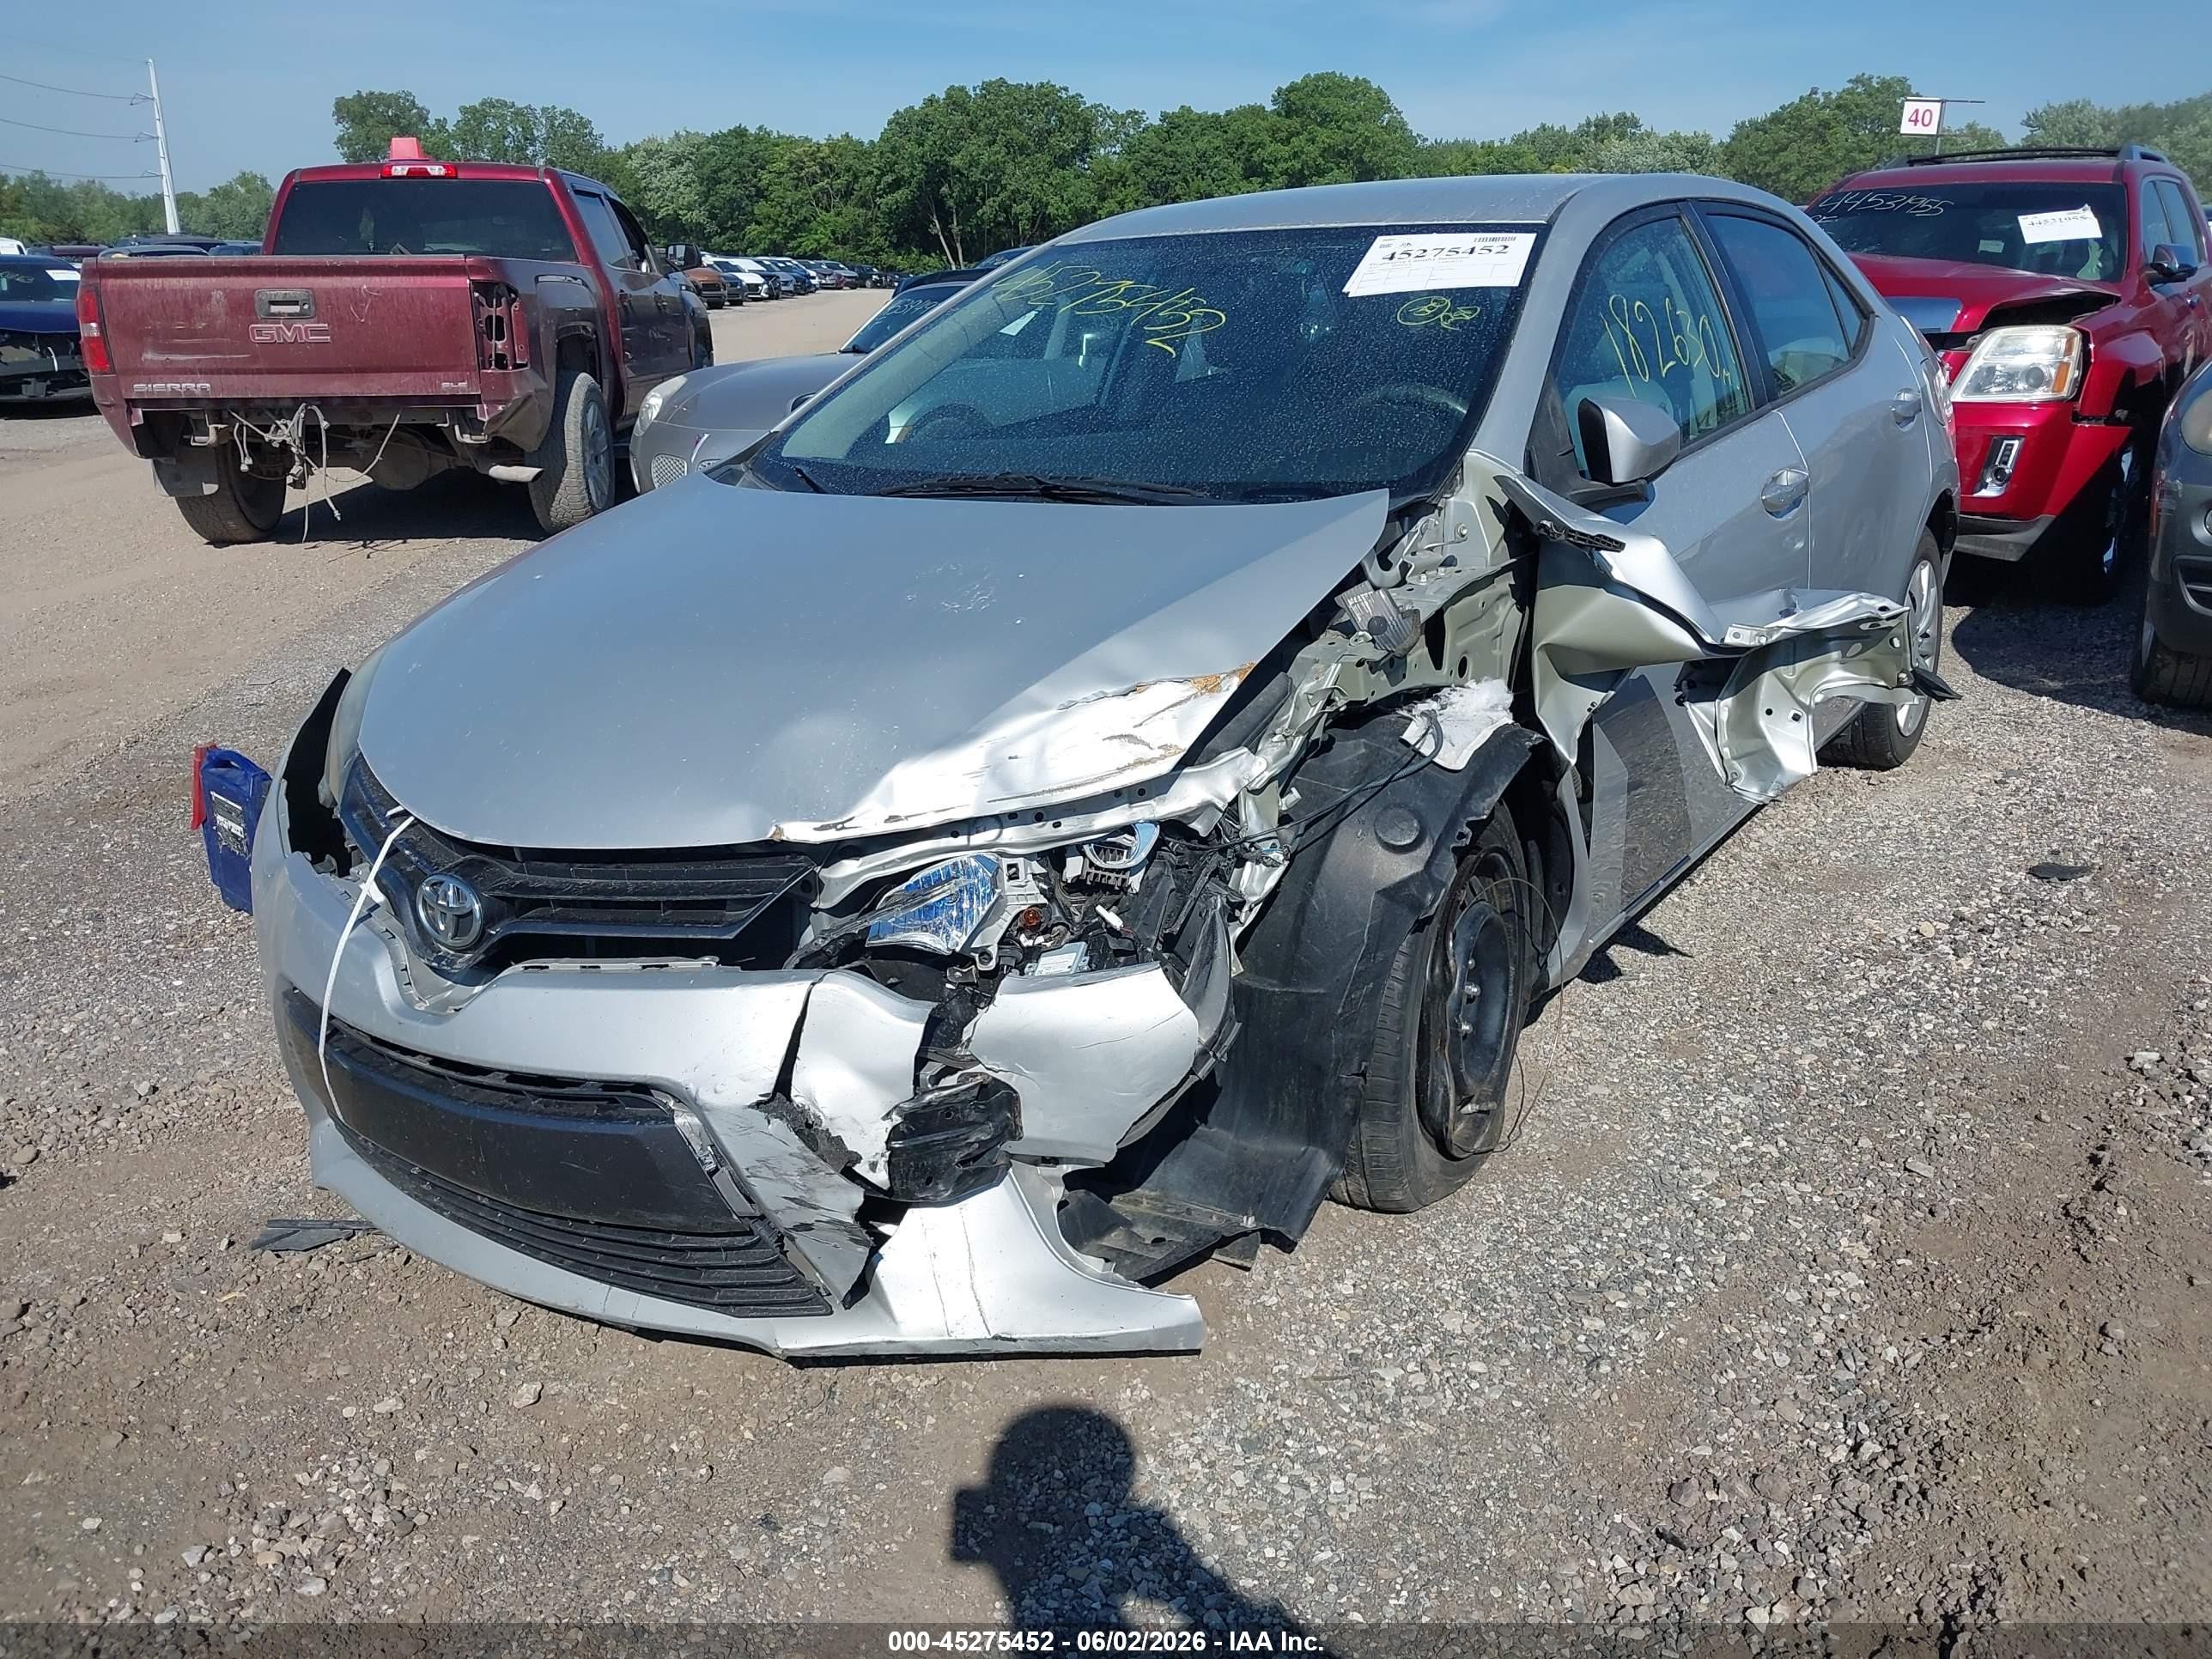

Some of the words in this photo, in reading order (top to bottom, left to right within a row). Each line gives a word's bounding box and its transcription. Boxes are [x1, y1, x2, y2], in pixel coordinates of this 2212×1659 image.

[1908, 108, 1934, 127] 40
[1819, 191, 1955, 217] 44531955
[1382, 244, 1510, 261] 45275452
[992, 260, 1227, 358] 45275452
[248, 323, 331, 343] GMC
[1599, 294, 1720, 398] 182630
[133, 383, 211, 393] SIERRA
